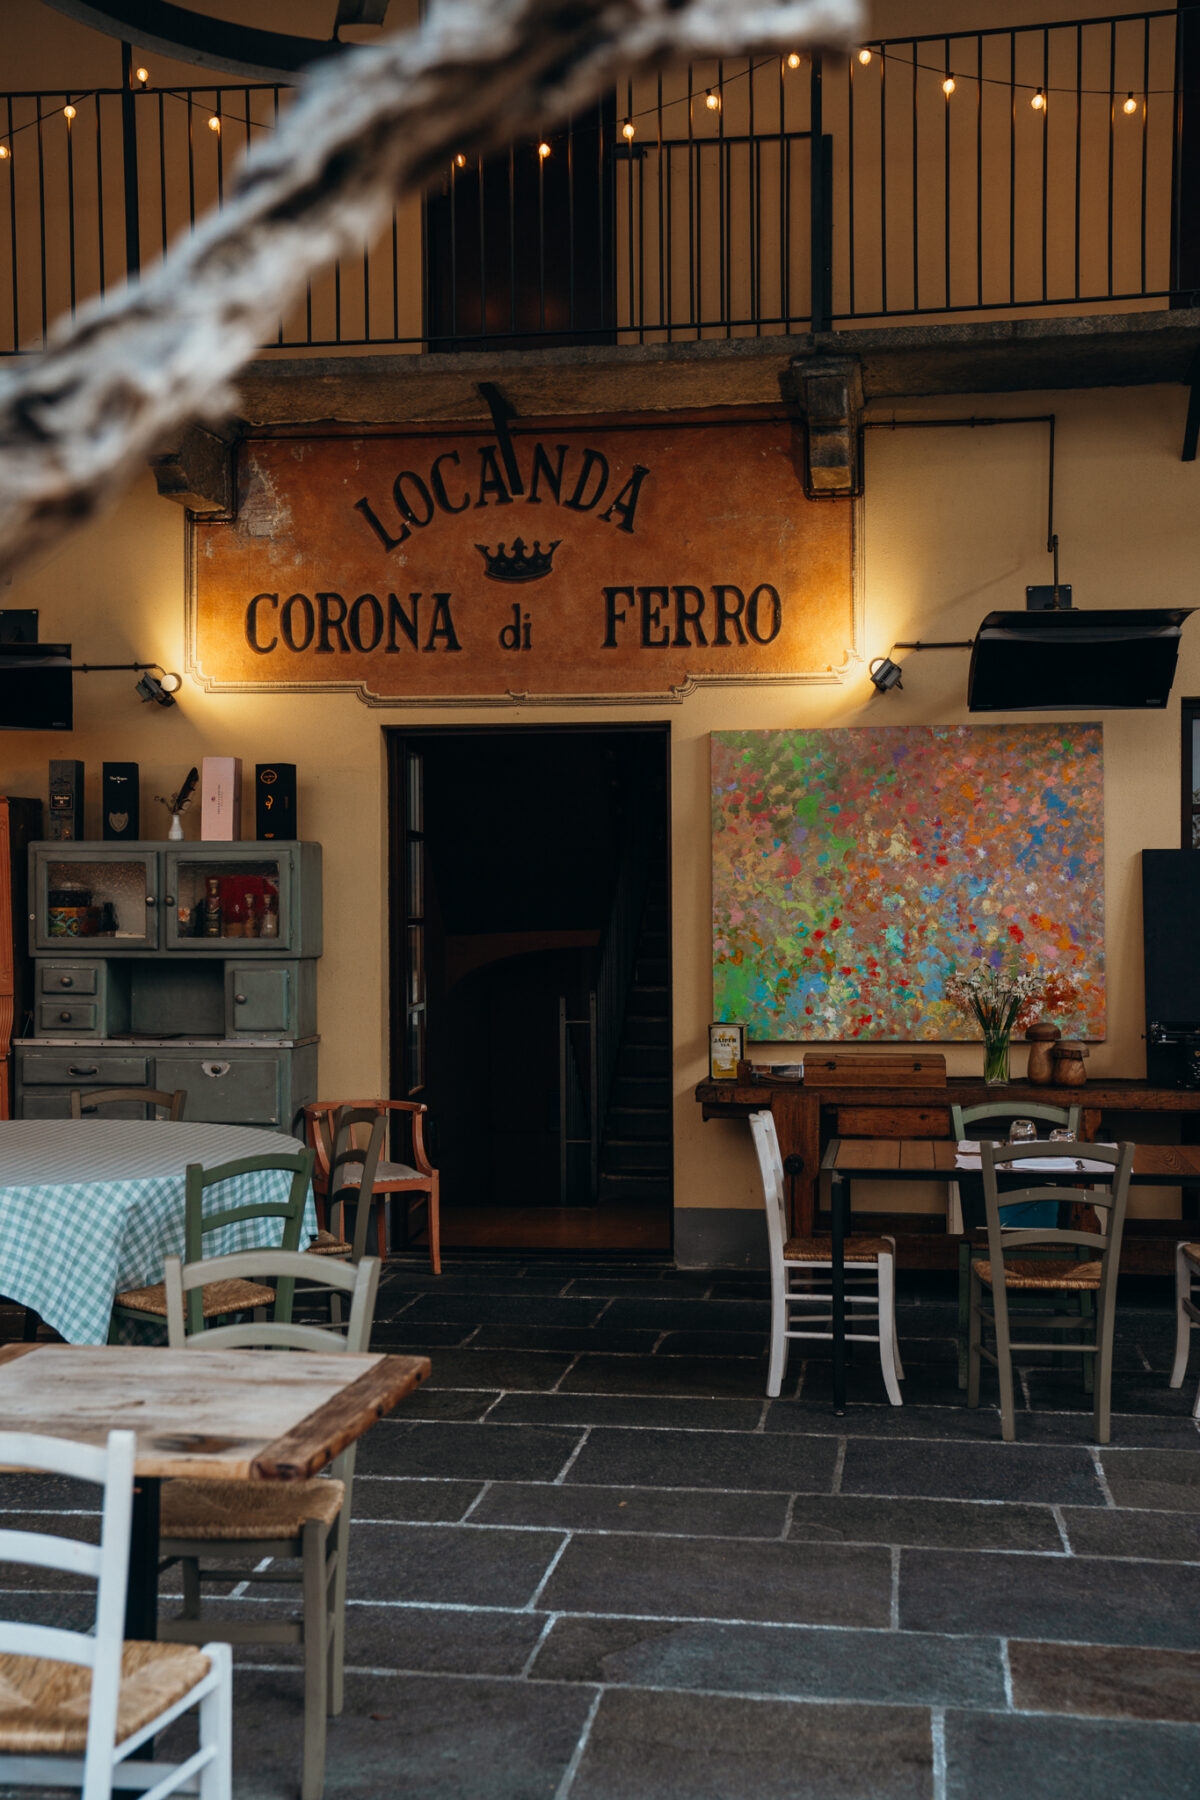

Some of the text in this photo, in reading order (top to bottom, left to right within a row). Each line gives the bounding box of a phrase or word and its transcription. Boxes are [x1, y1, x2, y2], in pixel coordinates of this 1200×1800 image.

[354, 442, 650, 552] LOCANDA
[245, 583, 781, 653] CORONA di FERRO
